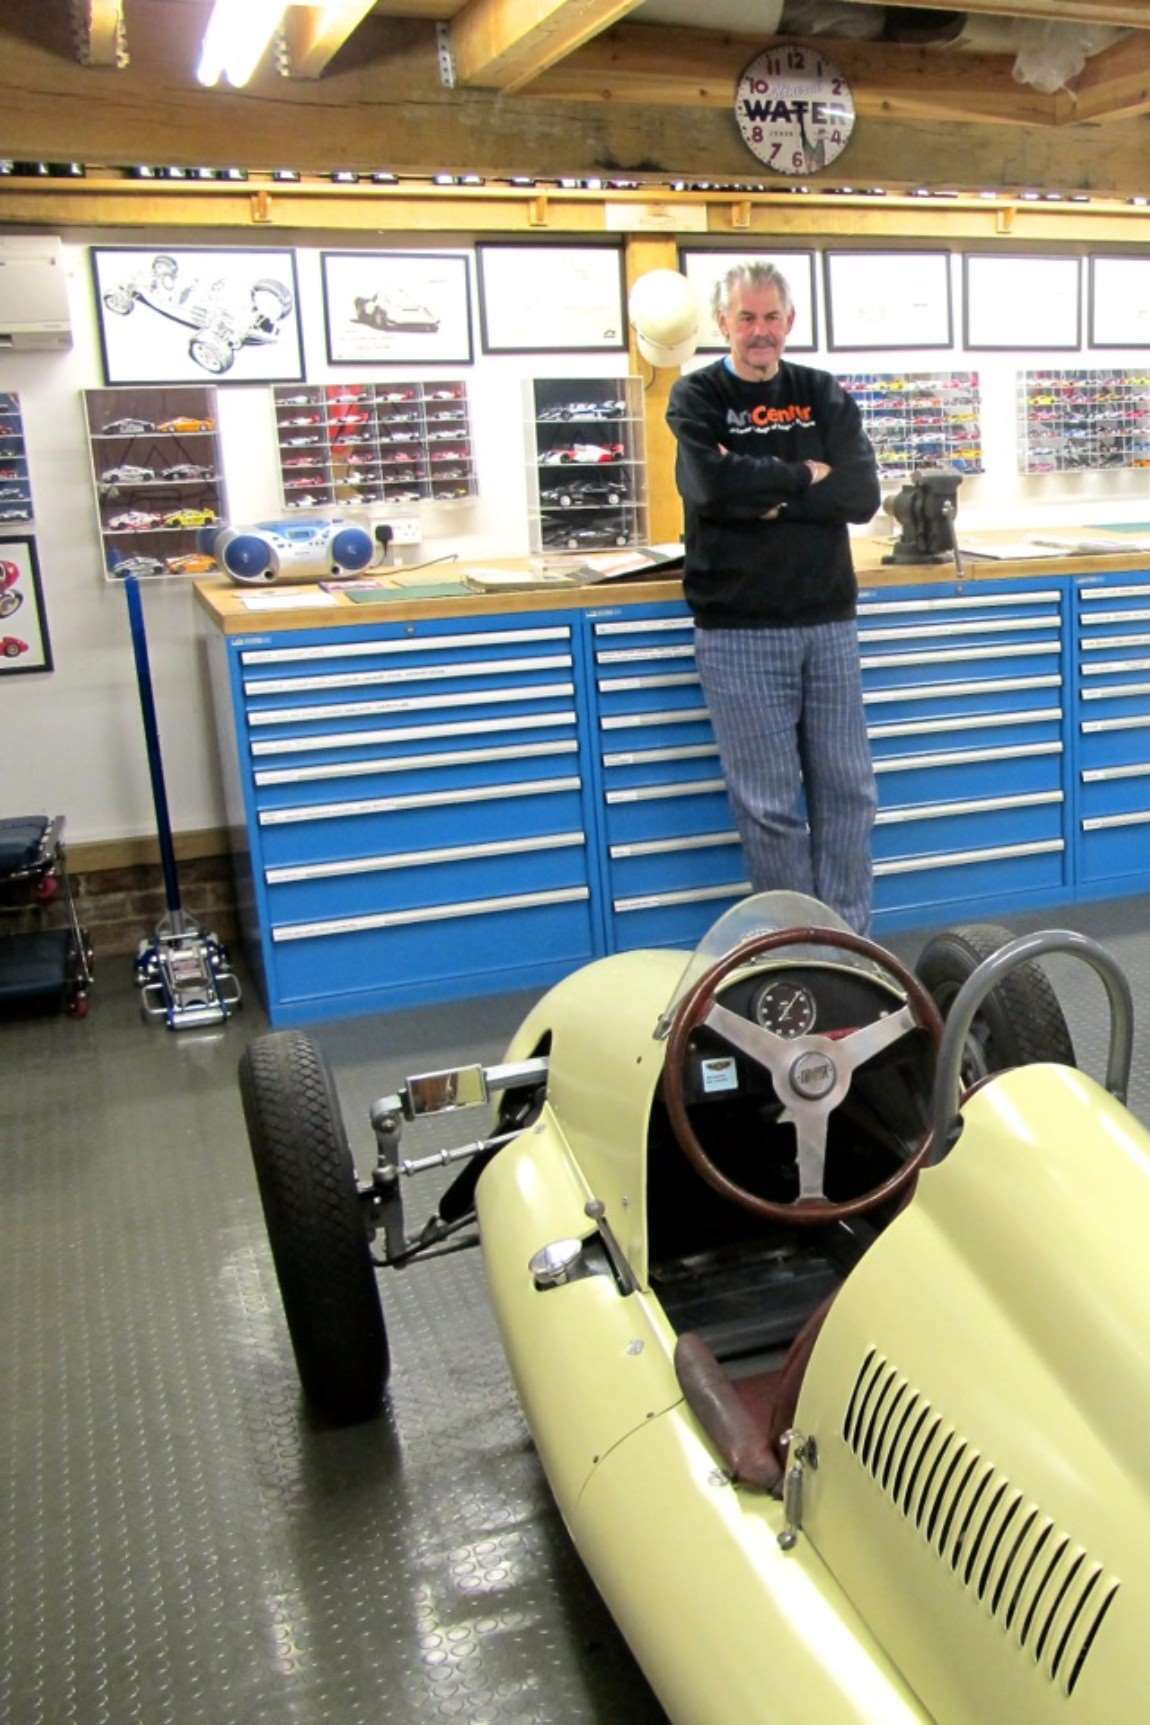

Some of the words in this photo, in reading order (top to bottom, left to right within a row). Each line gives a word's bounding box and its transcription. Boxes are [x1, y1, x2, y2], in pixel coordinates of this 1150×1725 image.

[766, 55, 781, 76] 11
[787, 52, 805, 70] 12
[816, 60, 823, 77] 1
[748, 77, 769, 94] 10
[831, 78, 842, 95] 2
[743, 99, 847, 124] WATER
[752, 126, 763, 143] 8
[831, 130, 841, 145] 4
[770, 143, 782, 160] 7
[791, 152, 803, 168] 6
